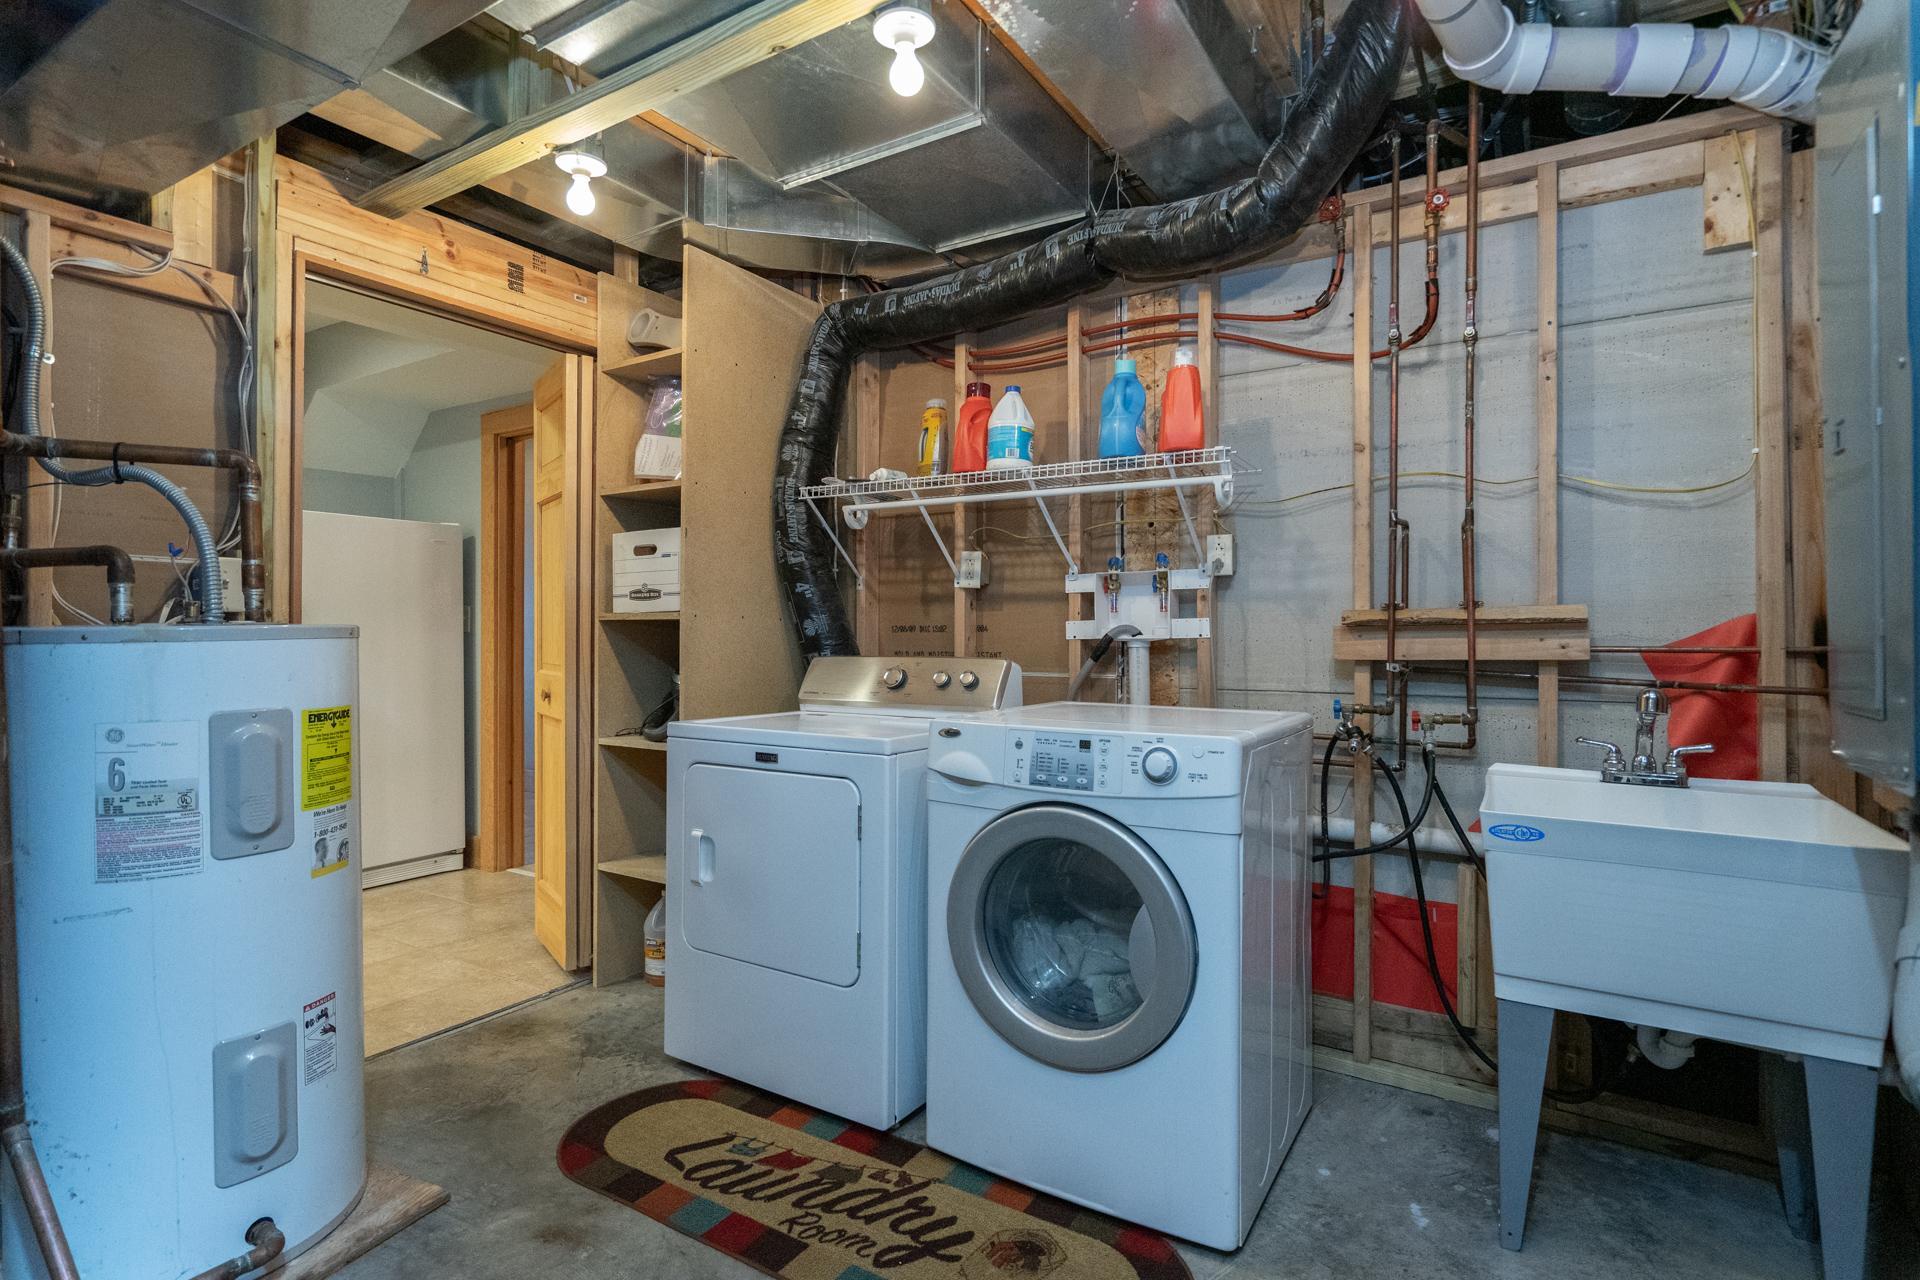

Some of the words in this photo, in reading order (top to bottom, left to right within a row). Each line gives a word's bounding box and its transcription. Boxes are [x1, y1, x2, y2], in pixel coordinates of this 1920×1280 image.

[108, 757, 126, 792] 6
[311, 993, 335, 1008] DANGER
[664, 1133, 975, 1269] Laundry
[778, 1210, 878, 1258] Room
